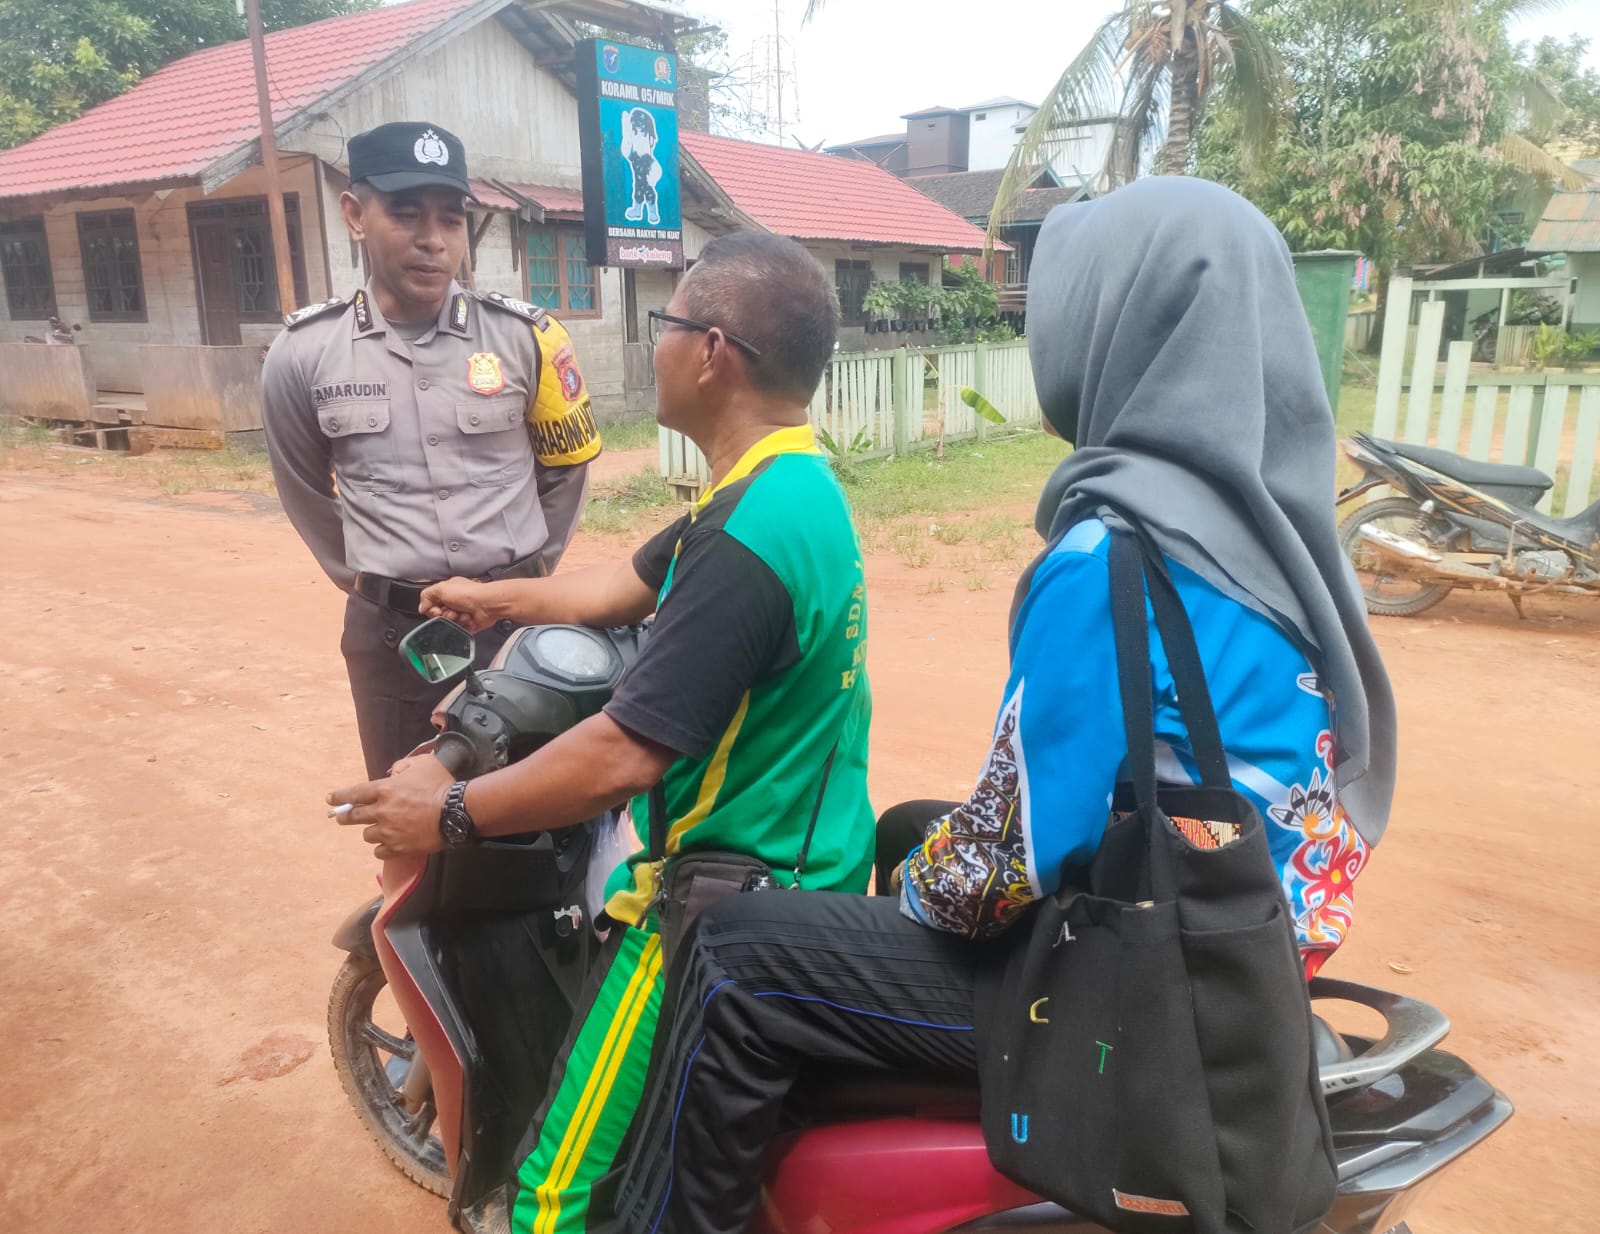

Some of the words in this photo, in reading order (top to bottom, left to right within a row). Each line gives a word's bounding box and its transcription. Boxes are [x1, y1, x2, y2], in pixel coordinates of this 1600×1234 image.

[601, 80, 640, 101] KORAMIL
[641, 87, 675, 107] 05/MRK
[608, 227, 636, 237] BERSAMA
[636, 228, 656, 239] RAKYAT
[657, 230, 666, 239] TNI
[667, 231, 680, 240] KUAT
